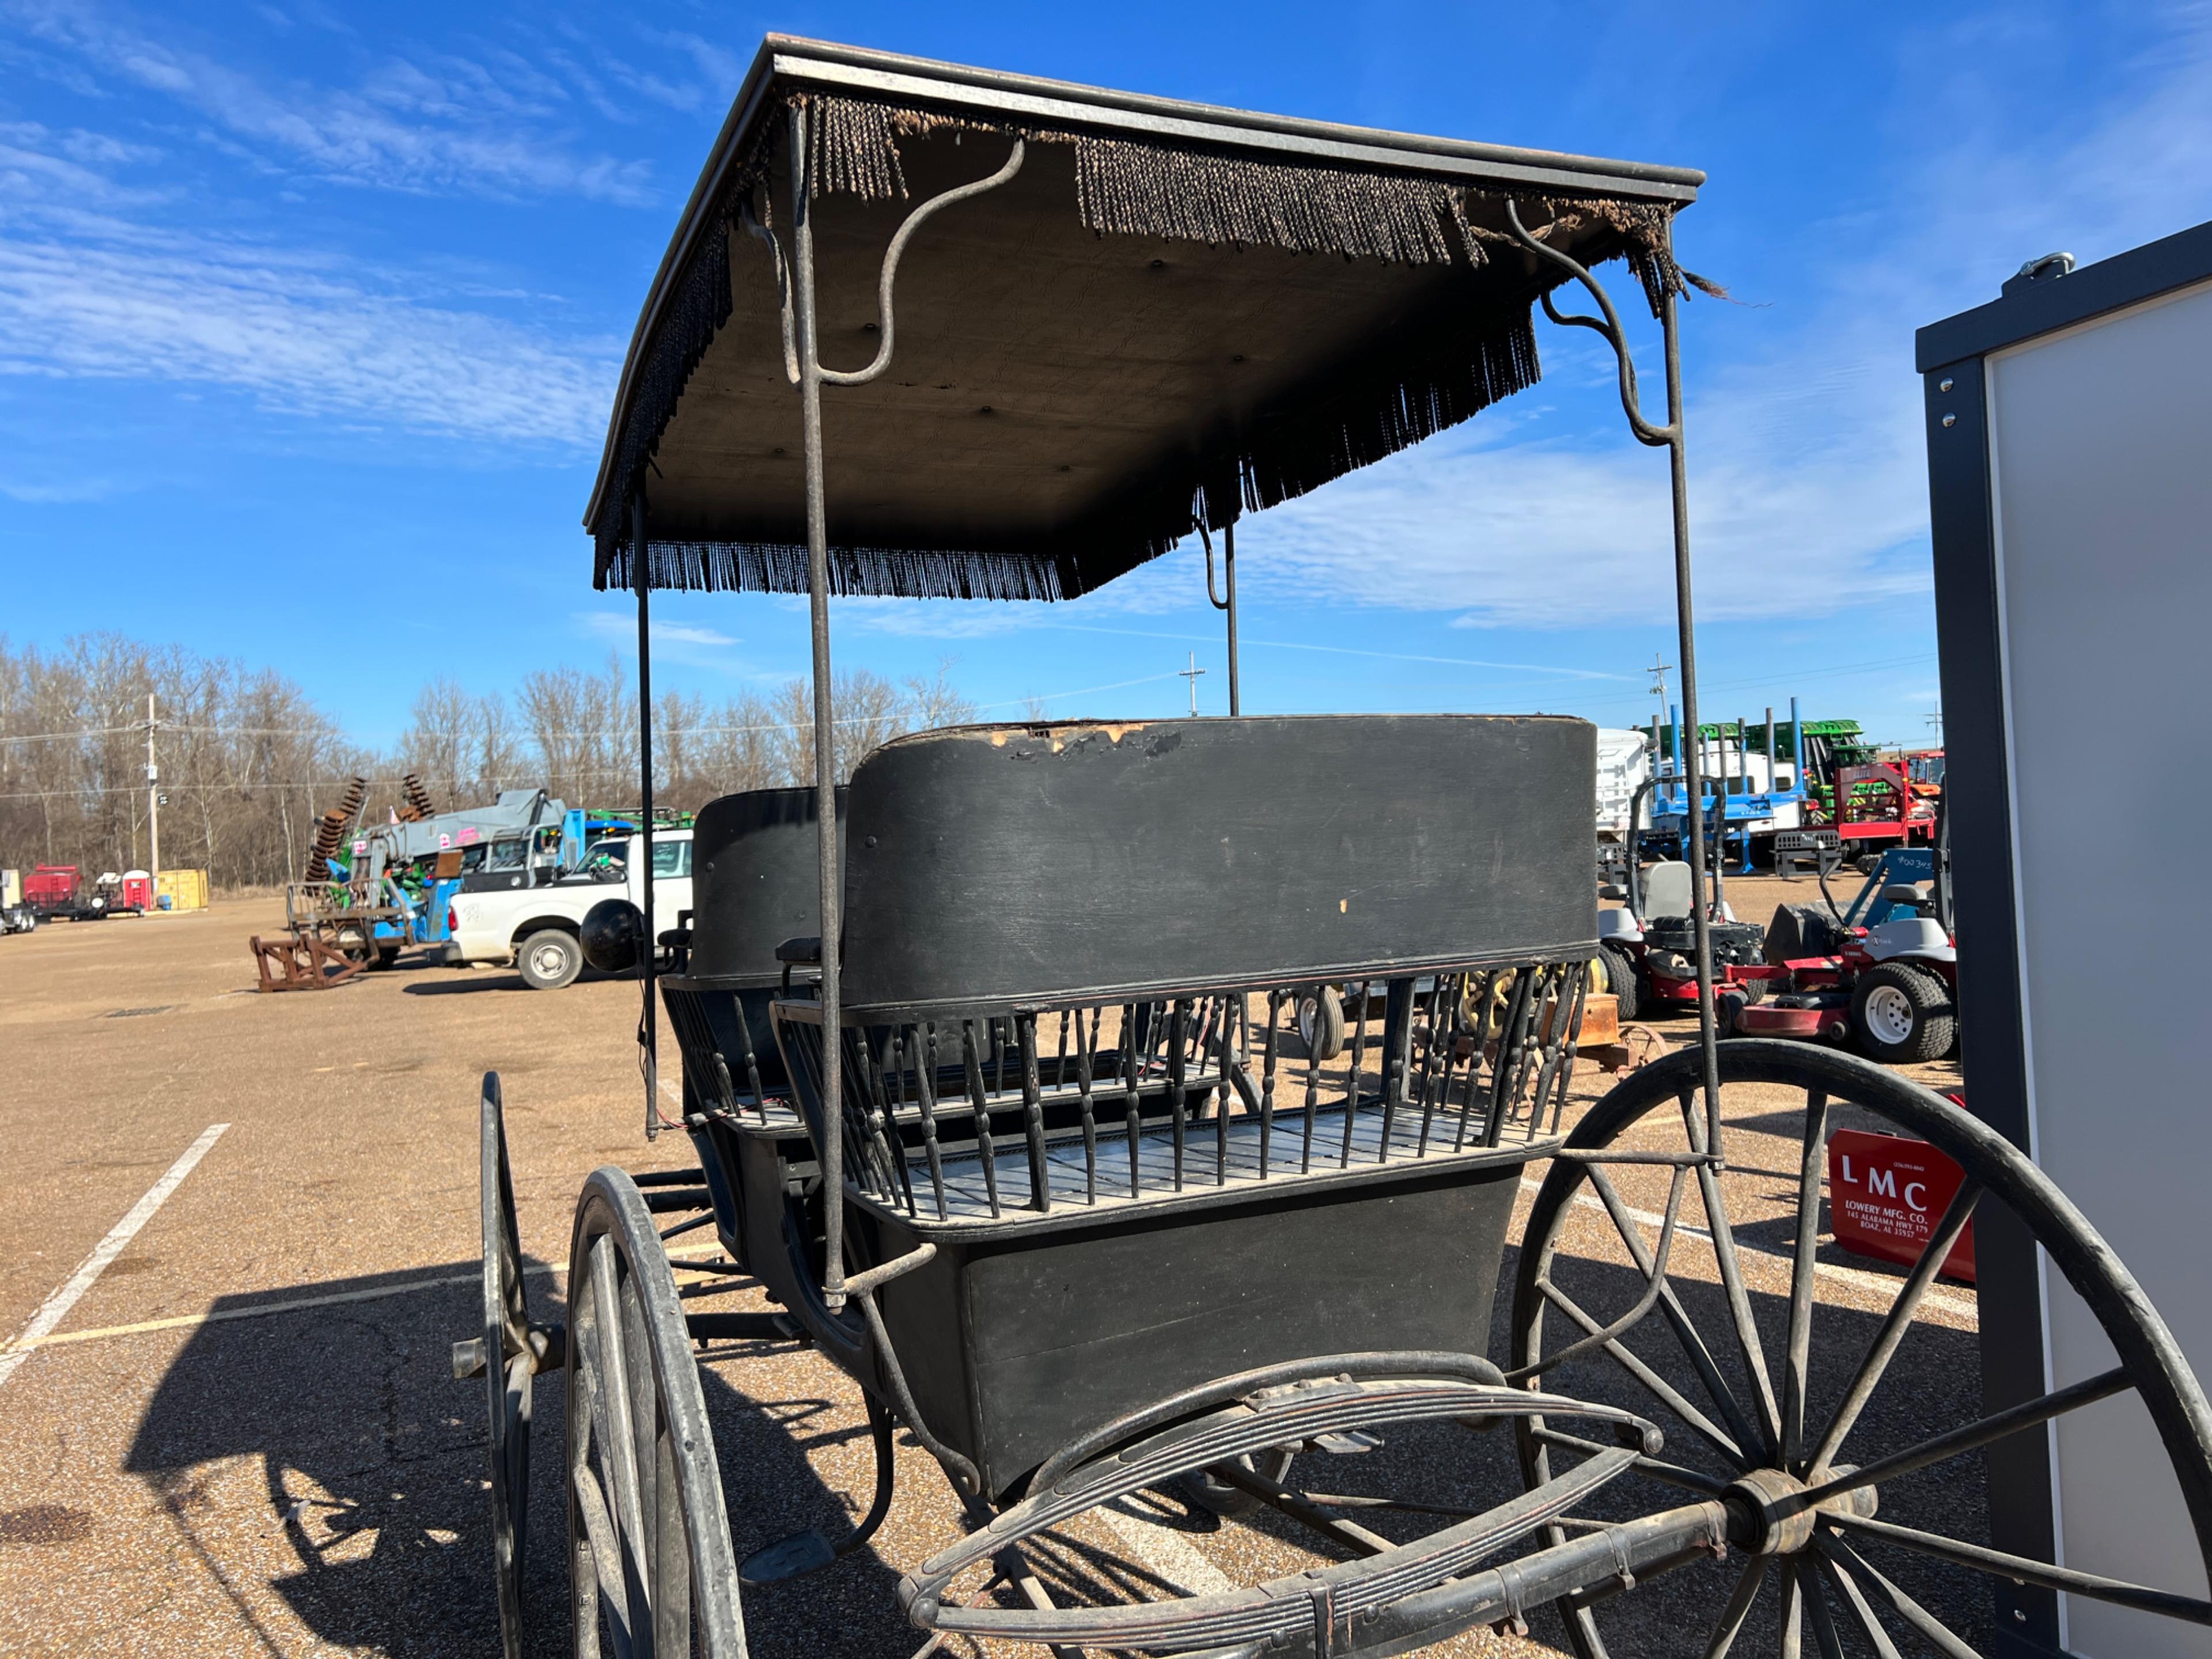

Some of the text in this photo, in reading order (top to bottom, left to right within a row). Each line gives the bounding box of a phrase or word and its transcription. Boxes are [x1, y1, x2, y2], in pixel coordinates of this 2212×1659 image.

[1846, 1200, 1928, 1225] LOWERY MFG. CO.
[1861, 1214, 1893, 1226] ALABAMA
[1896, 1221, 1913, 1230] HWY
[1916, 1225, 1929, 1233] 179
[1861, 1220, 1915, 1238] BOAZ, AL 35957
